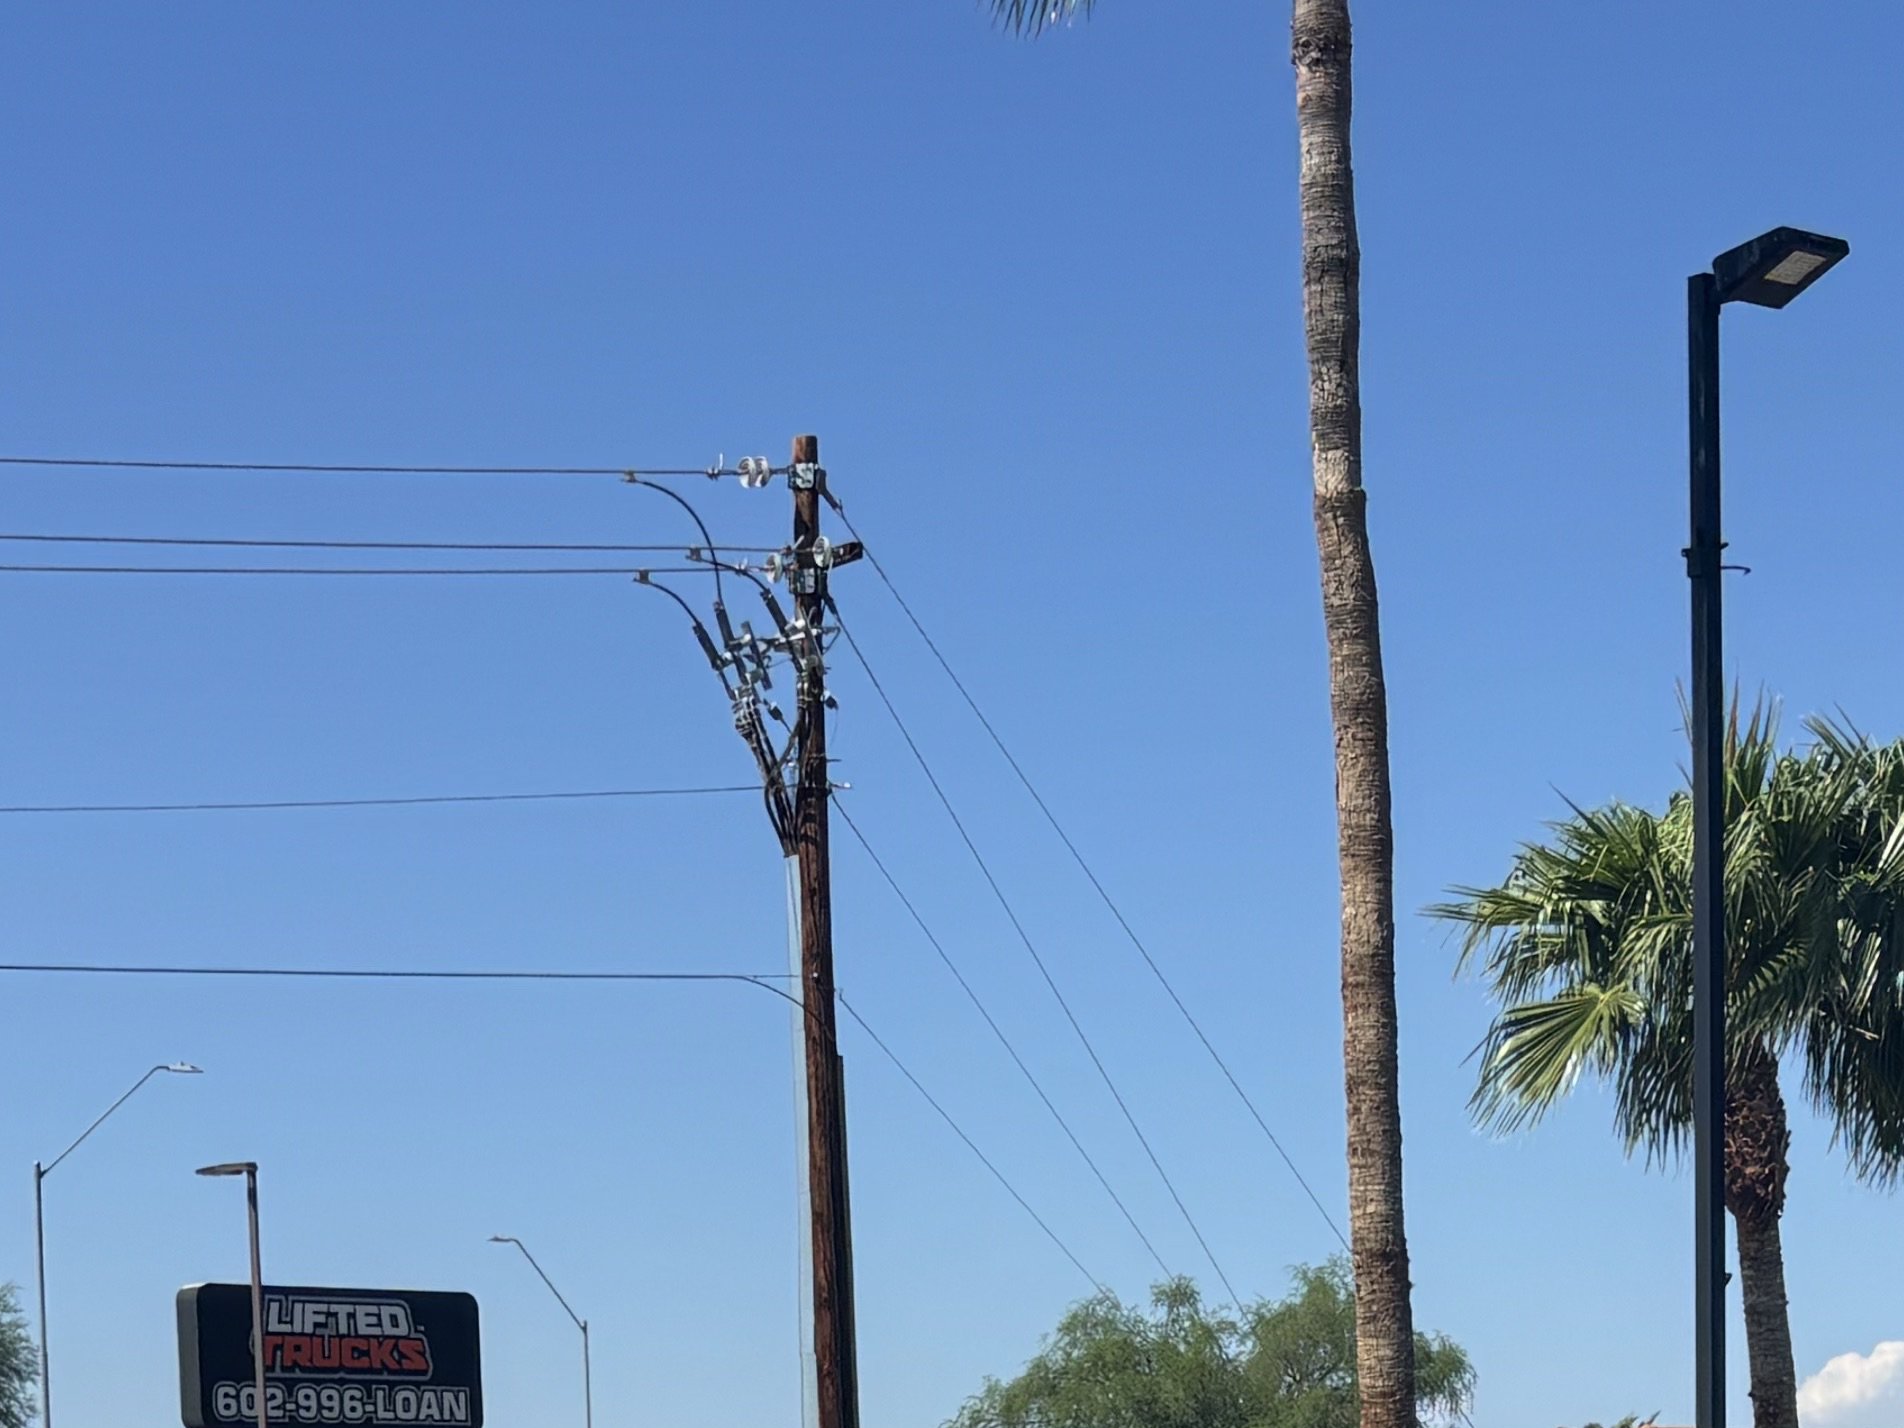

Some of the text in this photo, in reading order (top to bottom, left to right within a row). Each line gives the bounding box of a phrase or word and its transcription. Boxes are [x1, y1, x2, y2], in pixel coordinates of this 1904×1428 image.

[268, 1301, 409, 1337] LIFTED
[263, 1335, 431, 1371] TRUCKS
[215, 1385, 469, 1421] 602-996-LOAN
